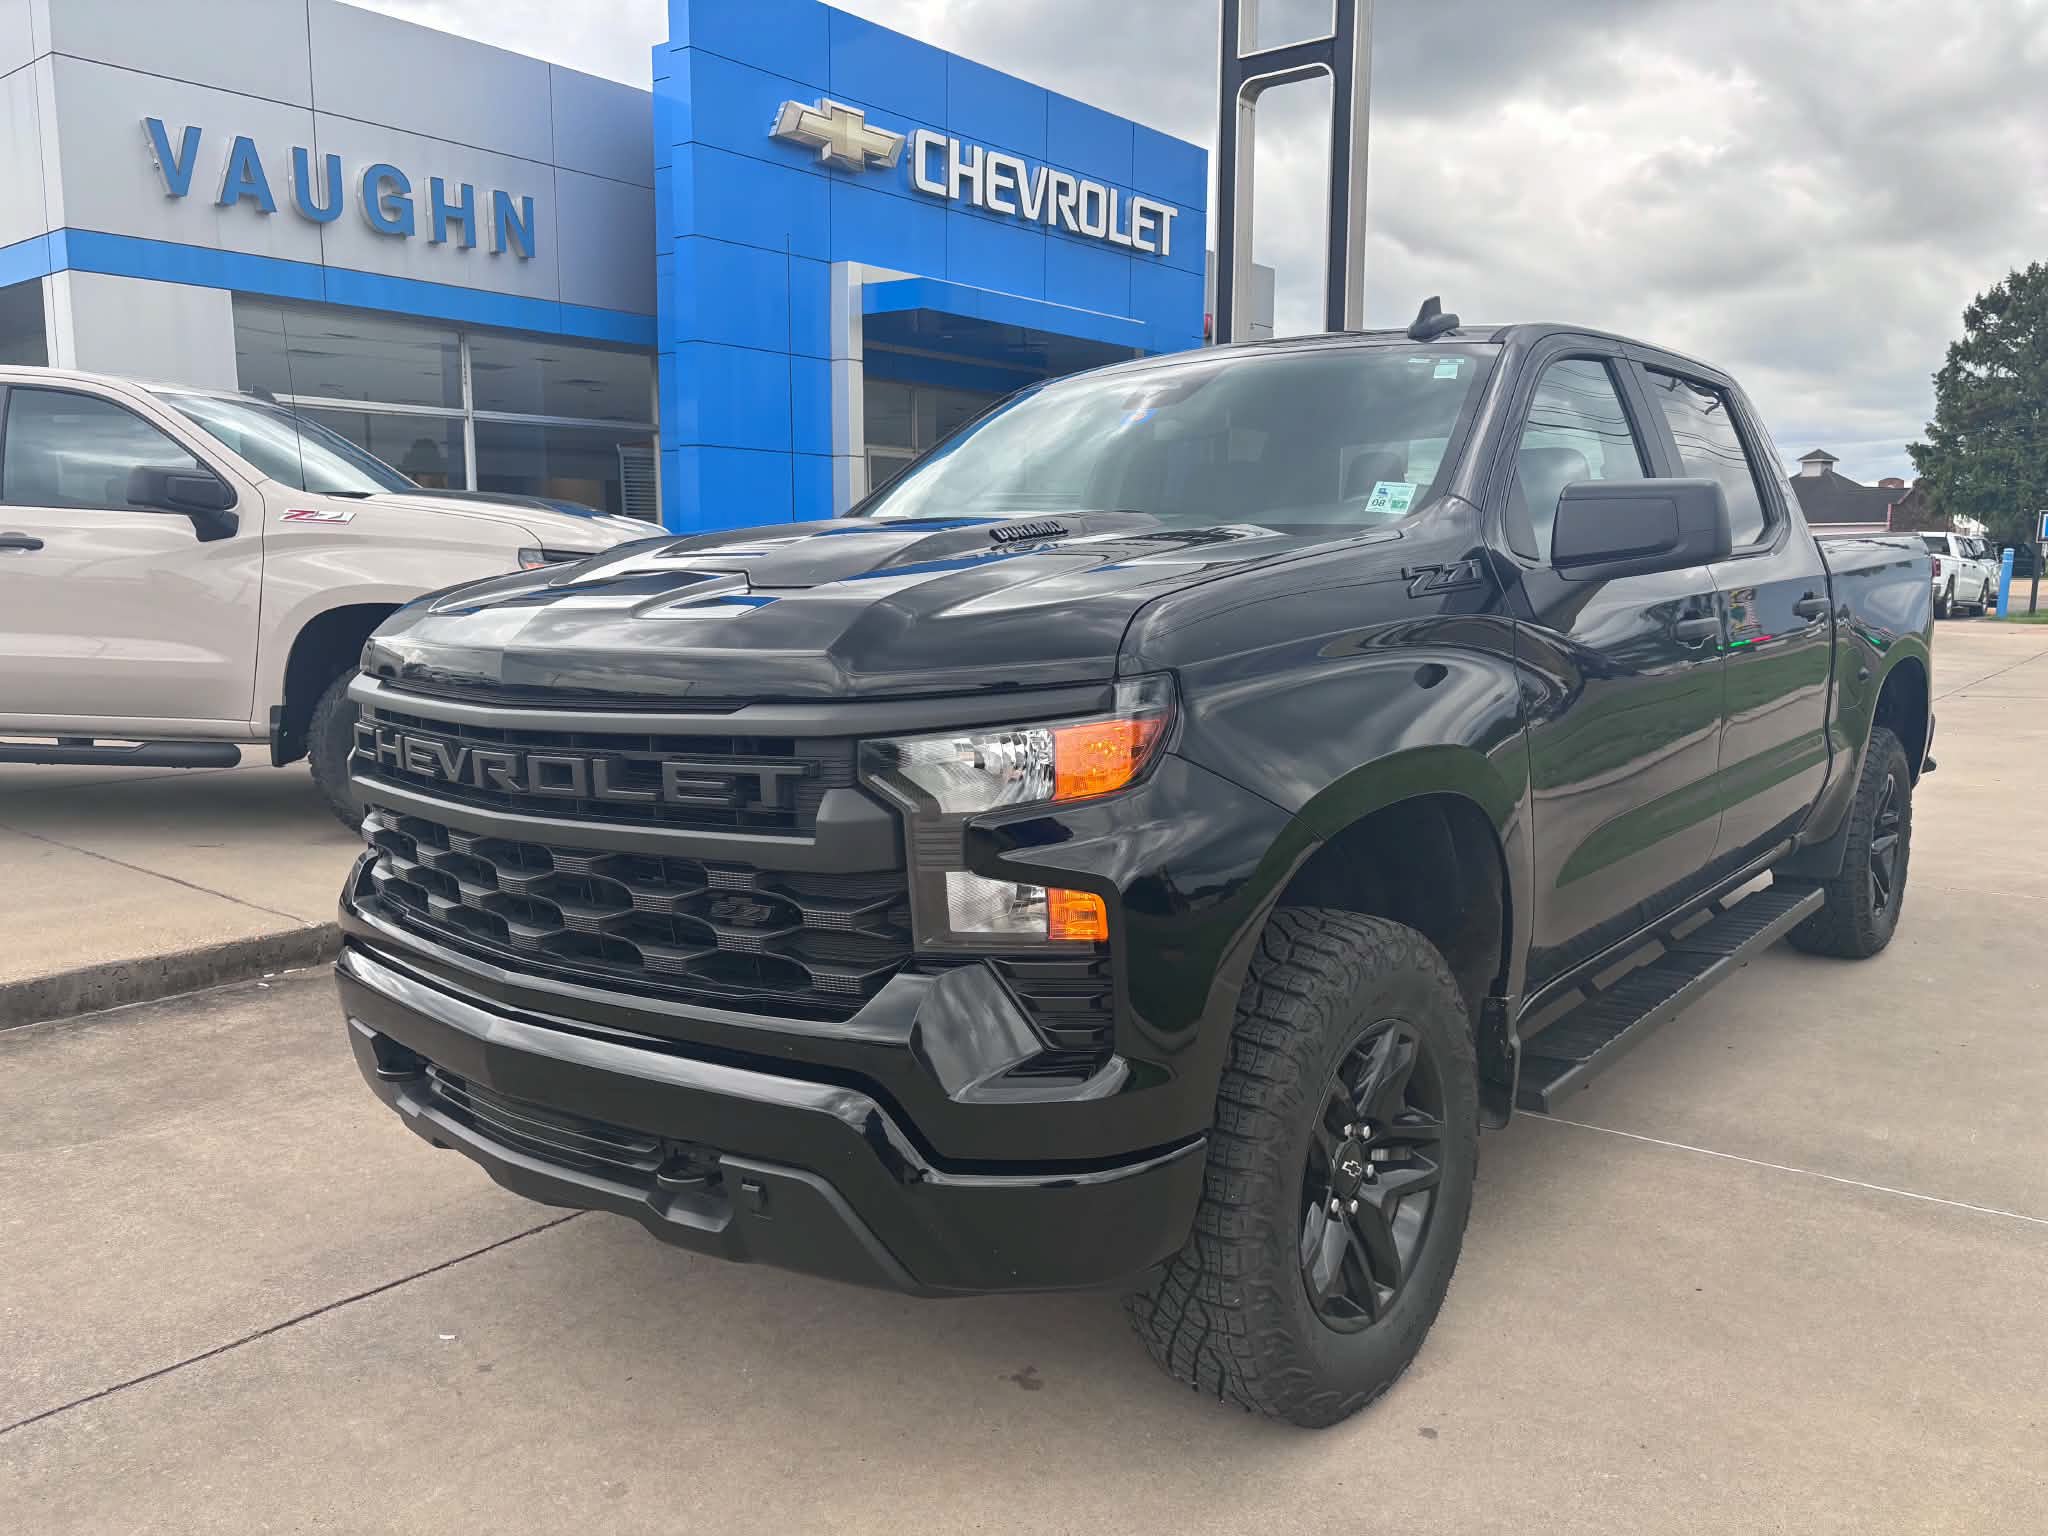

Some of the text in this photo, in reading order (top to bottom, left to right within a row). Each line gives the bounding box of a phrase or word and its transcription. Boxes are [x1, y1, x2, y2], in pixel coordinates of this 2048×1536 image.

[141, 117, 536, 259] VAUGHN
[908, 128, 1178, 257] CHEVROLET
[352, 721, 821, 810] CHEVROLET
